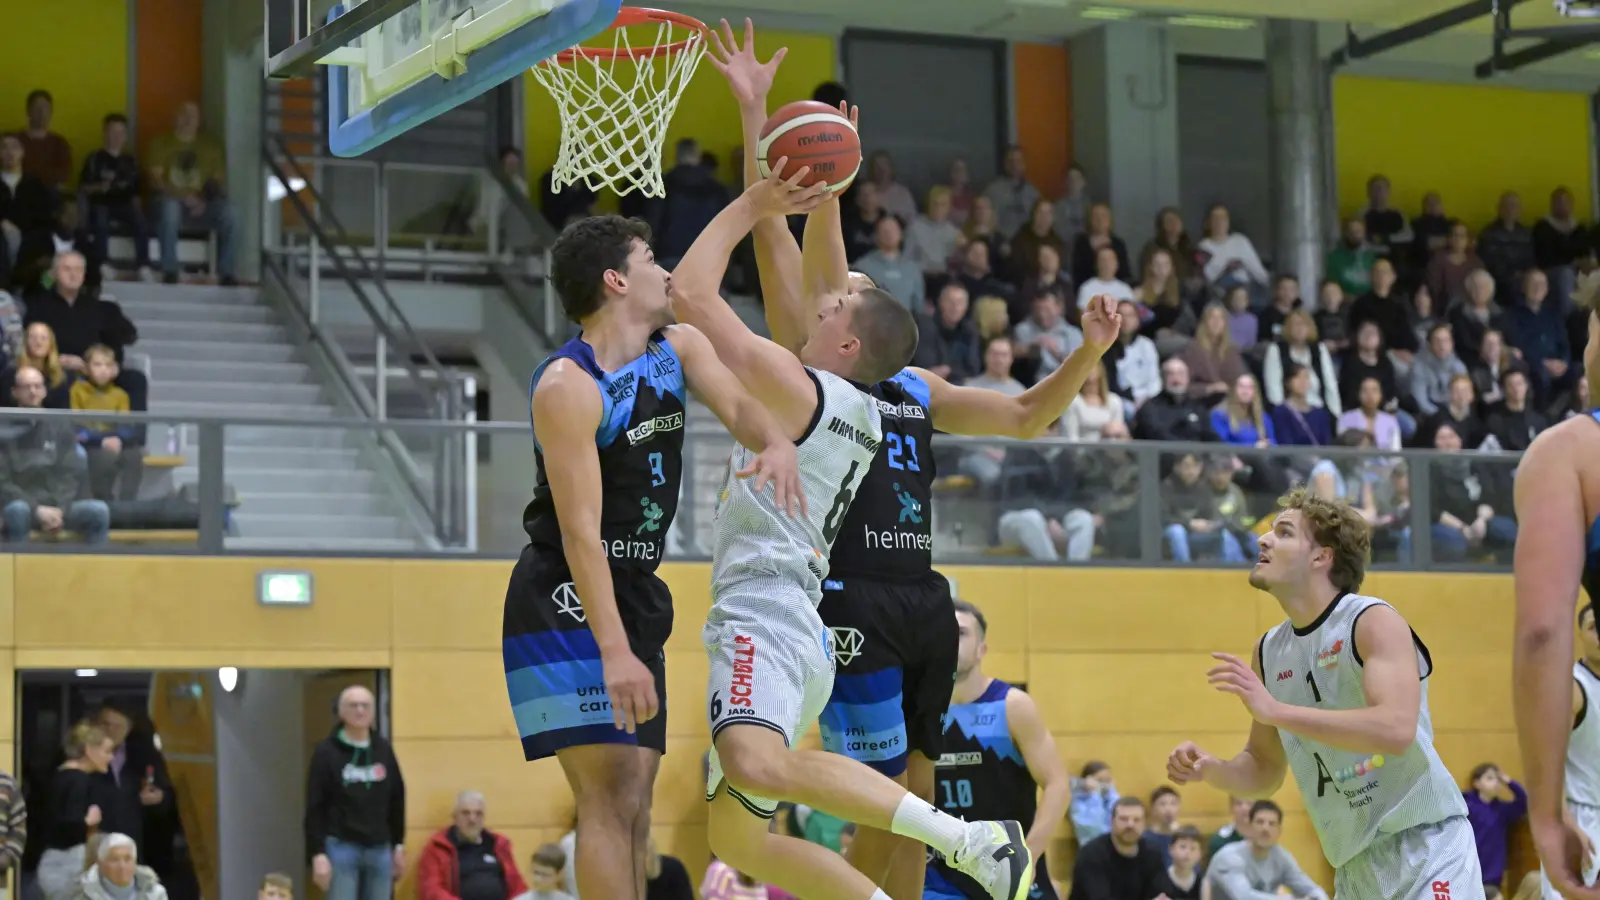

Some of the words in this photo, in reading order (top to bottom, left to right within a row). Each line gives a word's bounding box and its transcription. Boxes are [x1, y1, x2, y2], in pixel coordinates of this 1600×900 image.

[797, 132, 842, 147] molten
[813, 161, 835, 173] FIBA
[886, 431, 920, 472] 23
[648, 452, 666, 488] 9
[822, 459, 860, 546] 6
[576, 682, 605, 697] uni
[1305, 670, 1322, 703] 1
[711, 689, 722, 723] 6
[727, 708, 755, 716] JAKO
[846, 736, 900, 752] careers
[940, 779, 973, 809] 10
